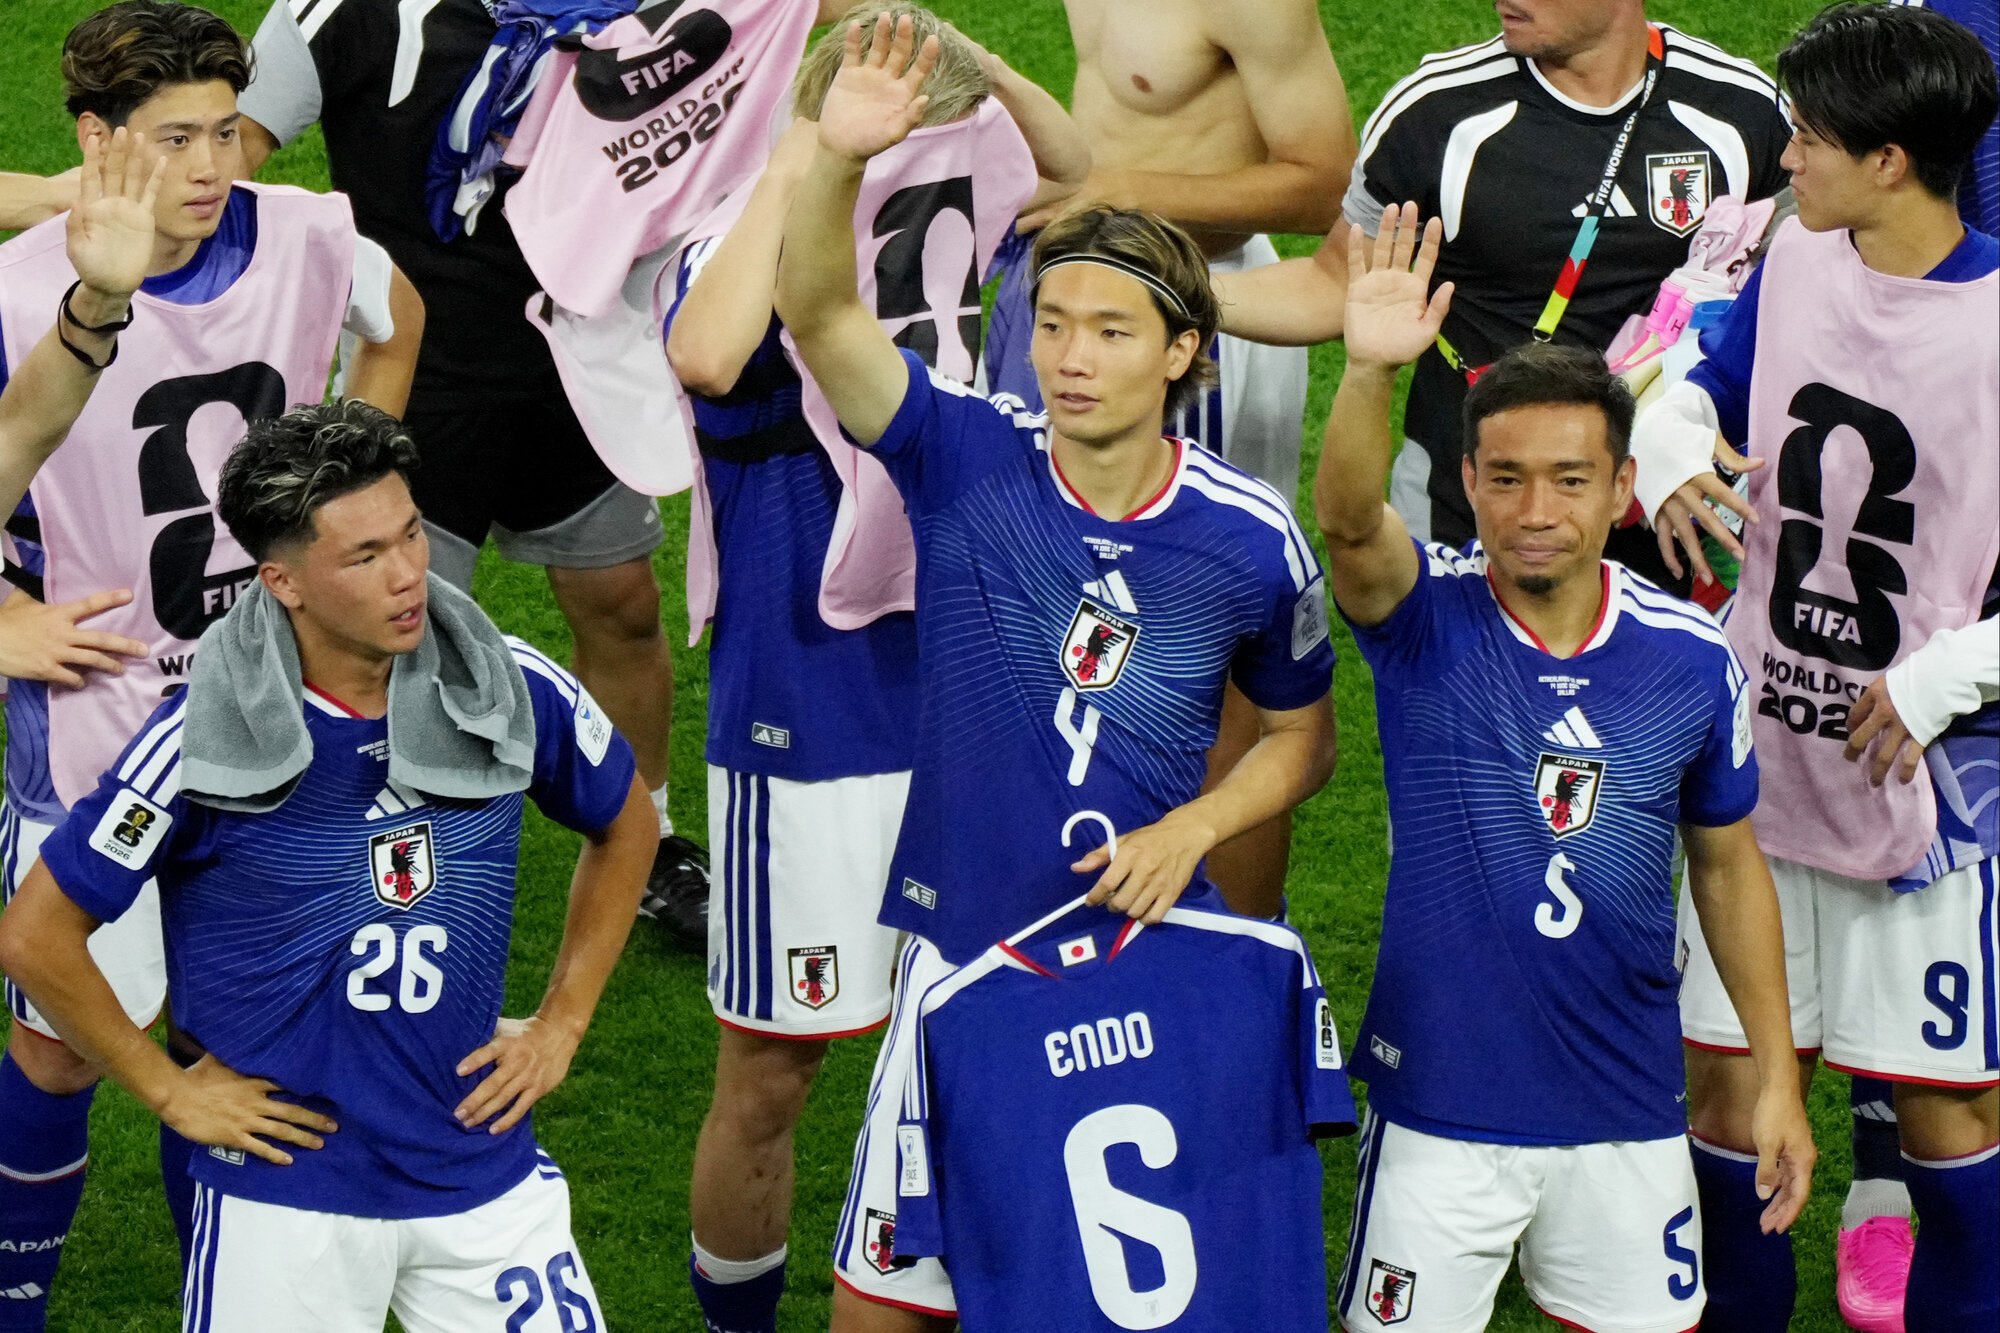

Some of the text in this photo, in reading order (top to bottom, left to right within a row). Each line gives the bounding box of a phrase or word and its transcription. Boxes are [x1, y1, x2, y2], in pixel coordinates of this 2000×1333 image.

[620, 50, 696, 96] FIFA
[602, 99, 698, 163] WORLD
[1595, 179, 1613, 206] FIFA
[1605, 133, 1628, 177] WORLD
[1662, 156, 1695, 166] JAPAN
[1667, 210, 1694, 222] JFA
[1093, 609, 1125, 629] JAPAN
[1793, 602, 1862, 645] FIFA
[1762, 652, 1841, 696] WORLD
[1758, 682, 1850, 742] 202
[1054, 687, 1101, 786] 4
[1555, 758, 1589, 769] JAPAN
[103, 842, 131, 861] 2026
[384, 827, 416, 842] JAPAN
[346, 923, 448, 1014] 26
[799, 947, 826, 955] JAPAN
[1921, 960, 1970, 1051] 9
[1044, 1011, 1154, 1077] ENDO
[876, 1211, 896, 1221] JAPA
[1064, 1104, 1198, 1330] 6
[0, 1235, 66, 1253] APAN
[1663, 1205, 1699, 1301] 5
[1382, 1263, 1407, 1276] JAPAN
[495, 1251, 597, 1333] 26
